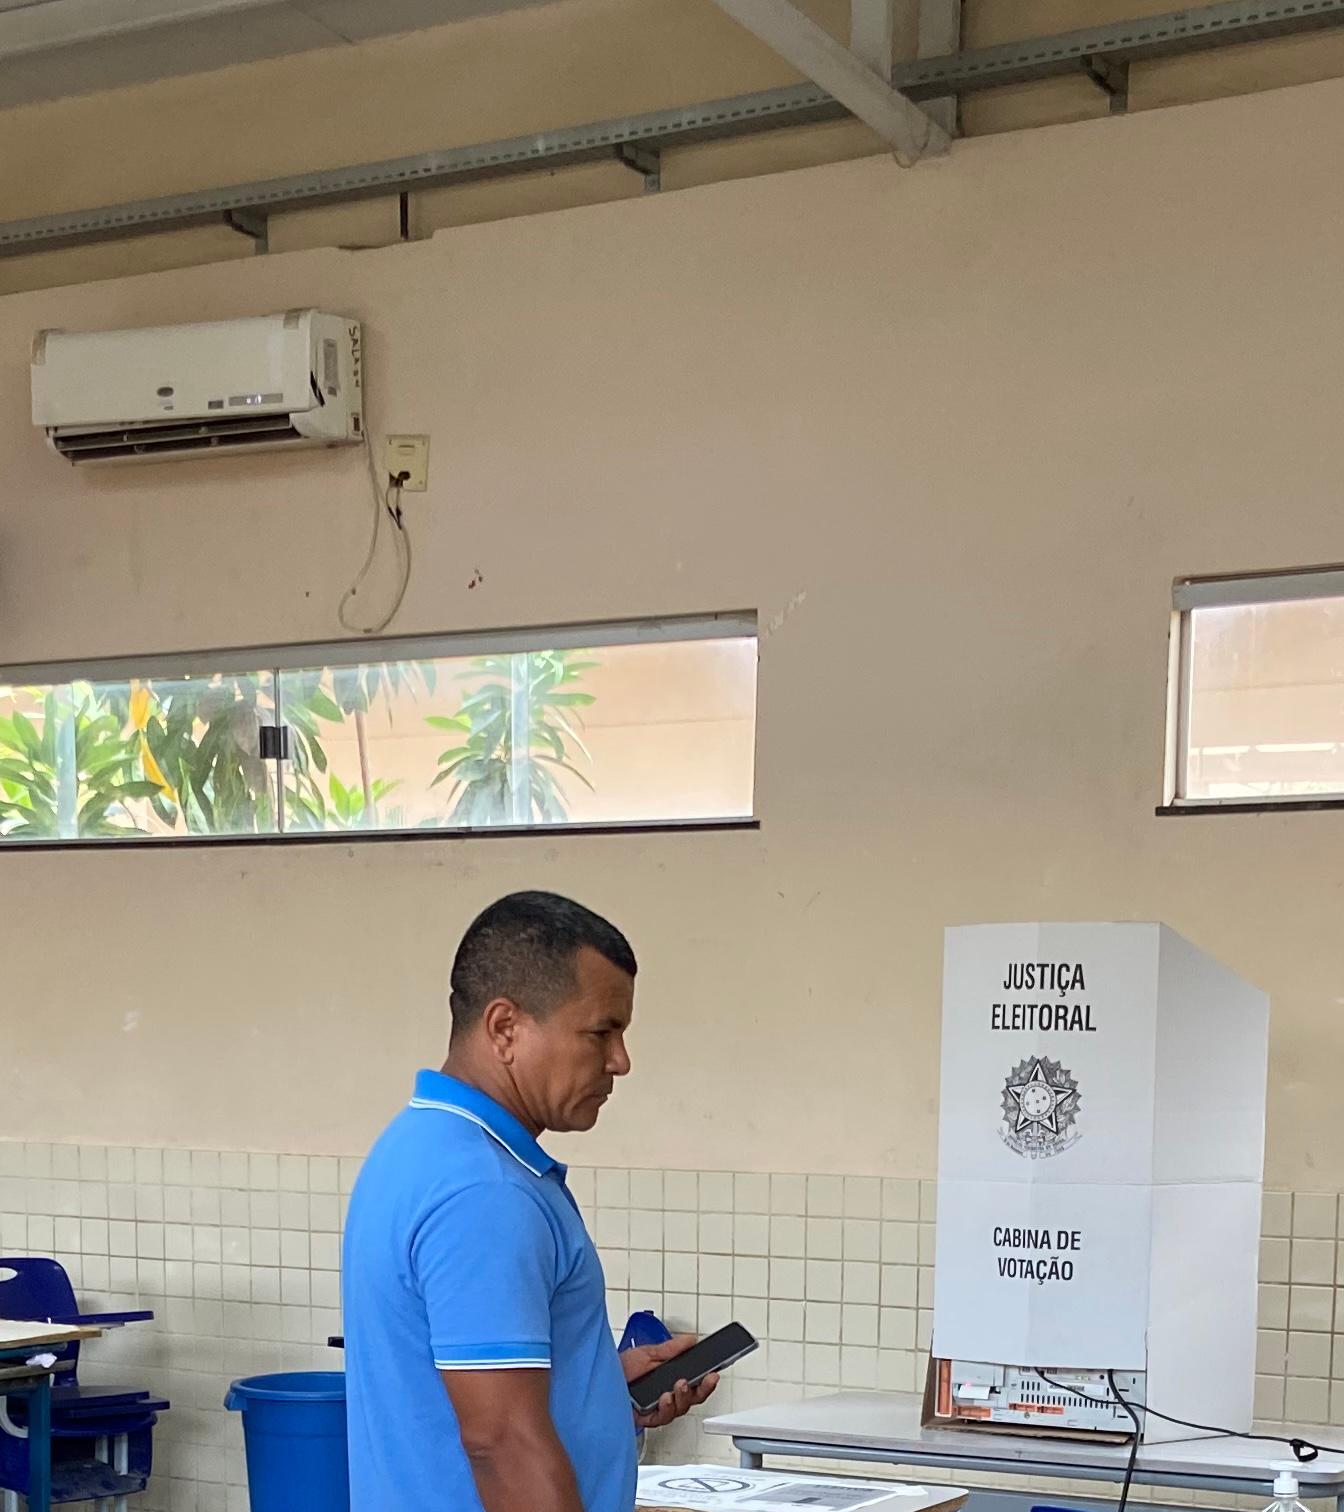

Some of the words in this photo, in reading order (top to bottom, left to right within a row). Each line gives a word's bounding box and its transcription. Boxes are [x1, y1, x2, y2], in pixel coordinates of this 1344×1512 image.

[1003, 963, 1085, 997] JUSTIÇA
[991, 1004, 1097, 1031] ELEITORAL
[993, 1227, 1052, 1249] CABINA
[1056, 1230, 1081, 1250] DE
[997, 1256, 1074, 1285] VOTAÇÃO
